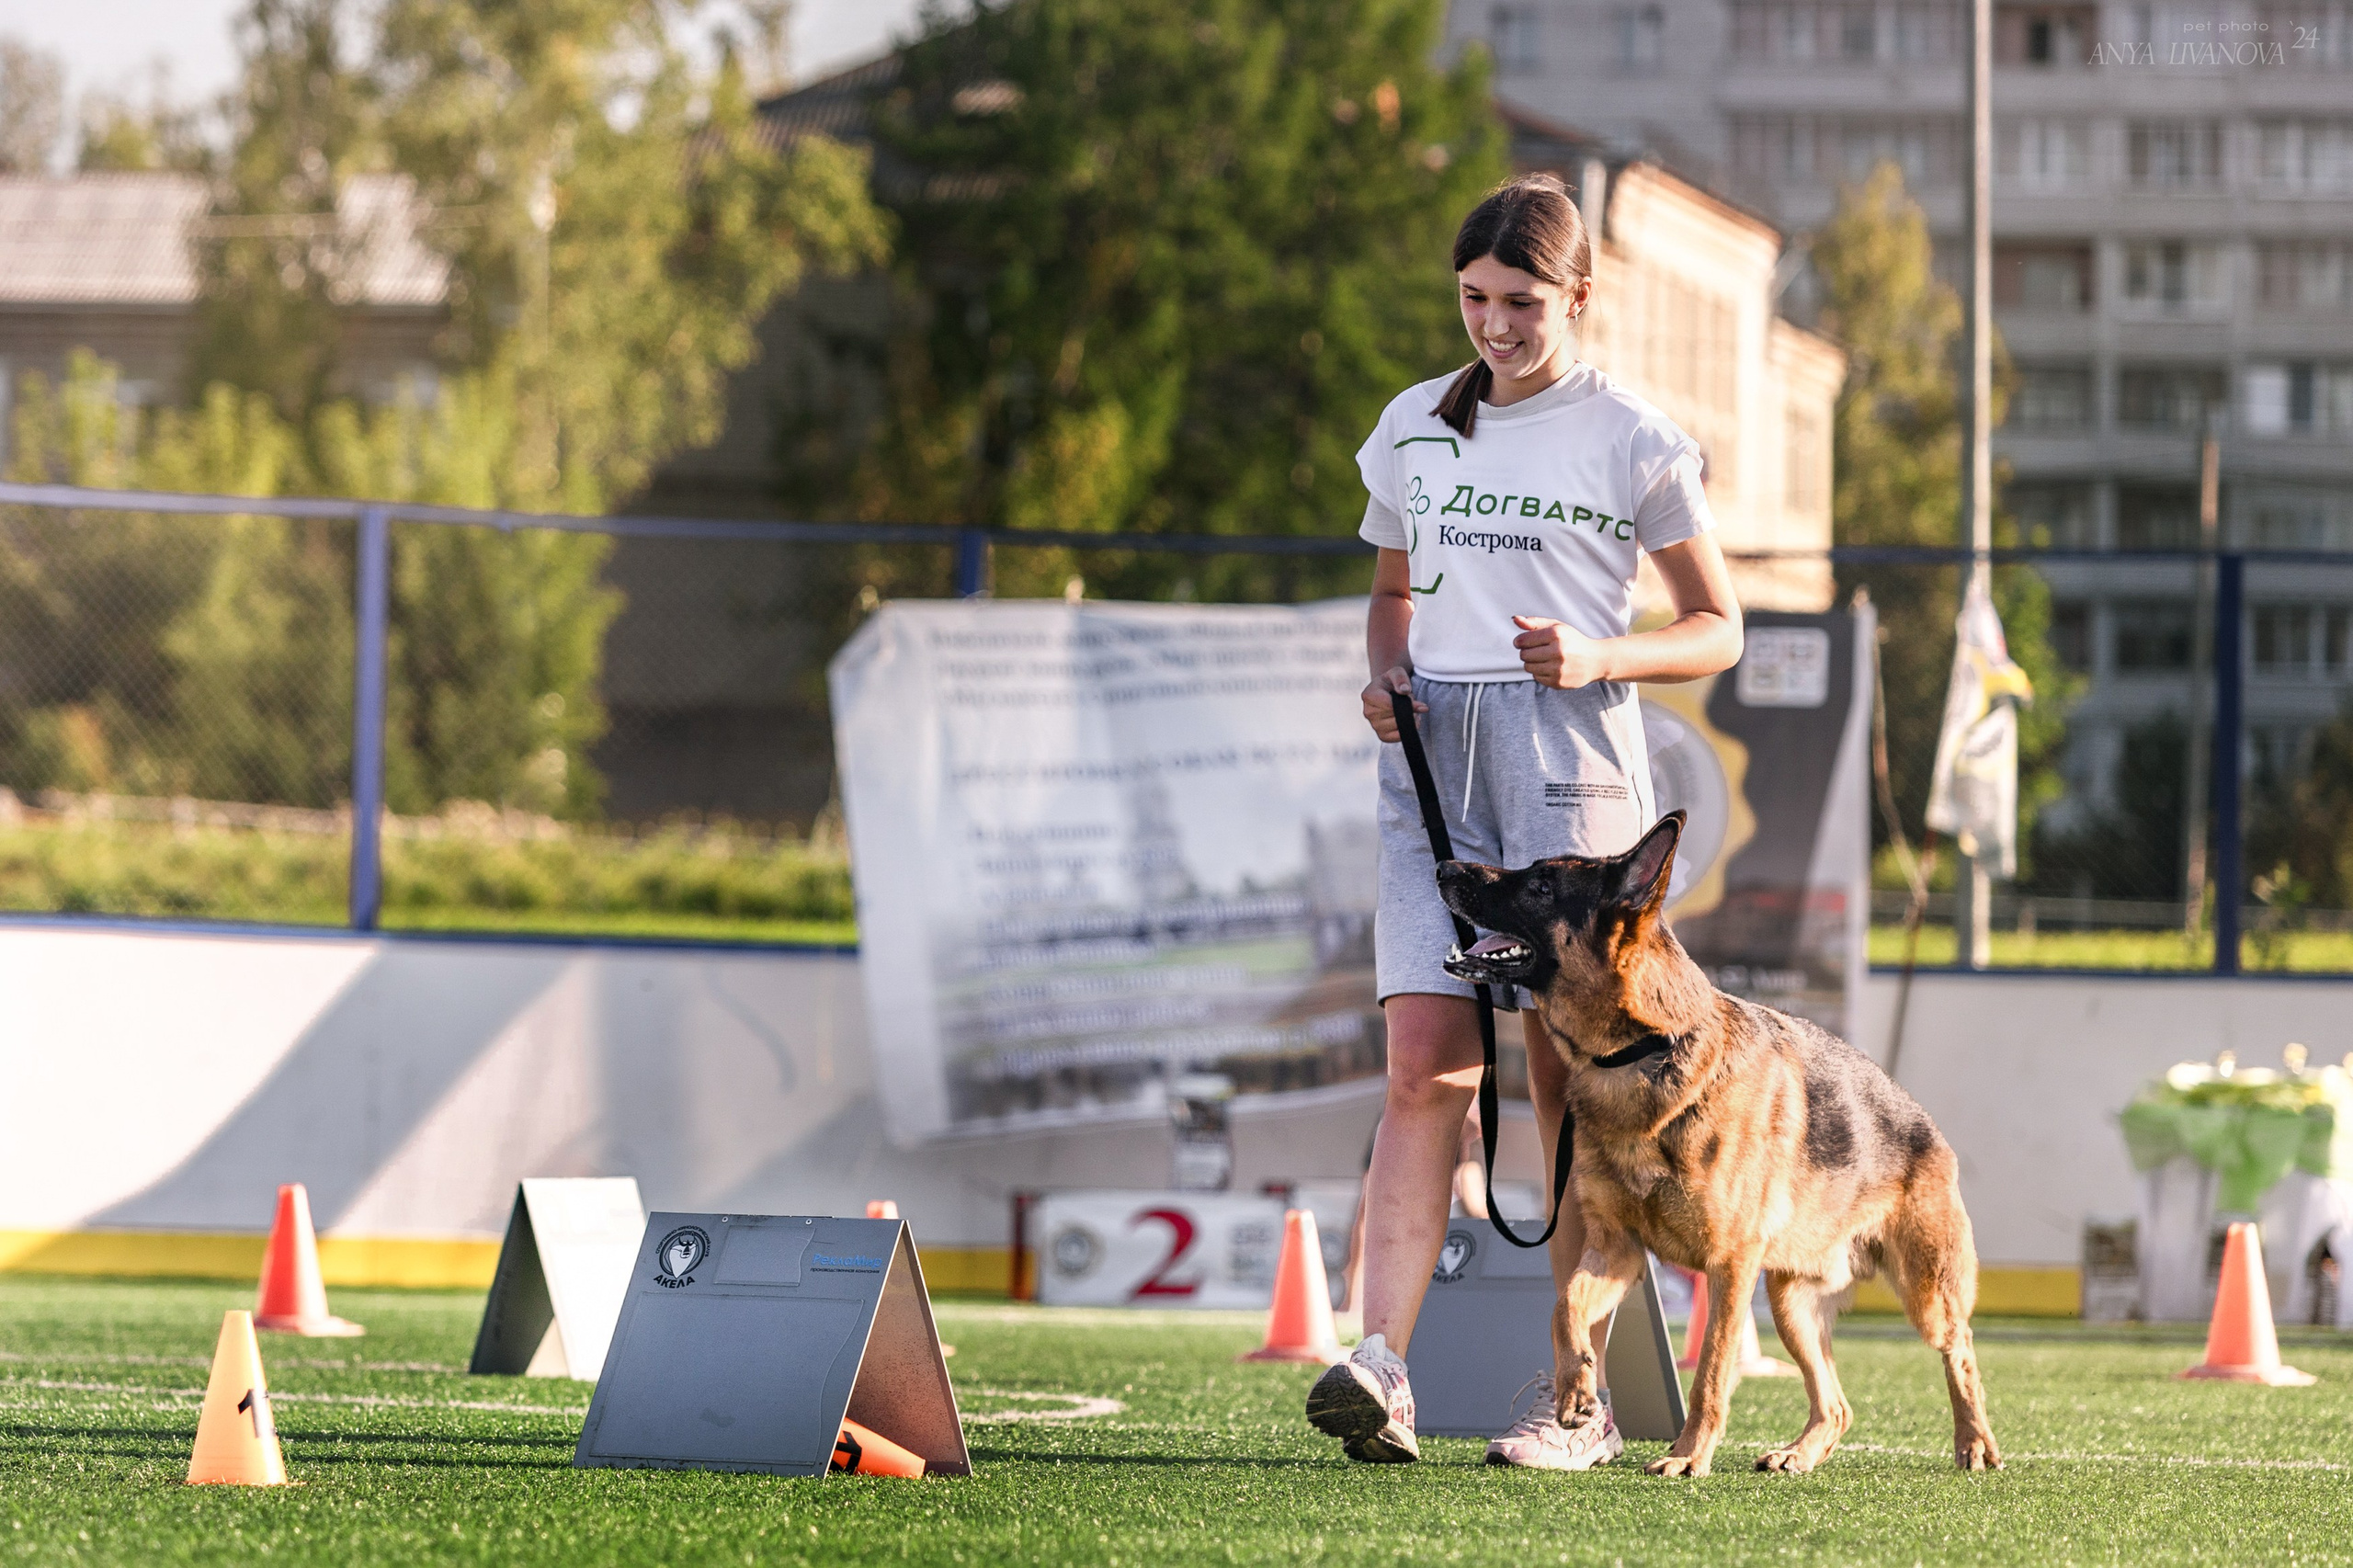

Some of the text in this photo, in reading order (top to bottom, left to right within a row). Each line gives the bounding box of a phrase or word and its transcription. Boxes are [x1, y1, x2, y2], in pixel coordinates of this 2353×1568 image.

[1438, 525, 1543, 553] Кострома
[1129, 1207, 1201, 1301] 2
[654, 1274, 696, 1289] АКЕЛА
